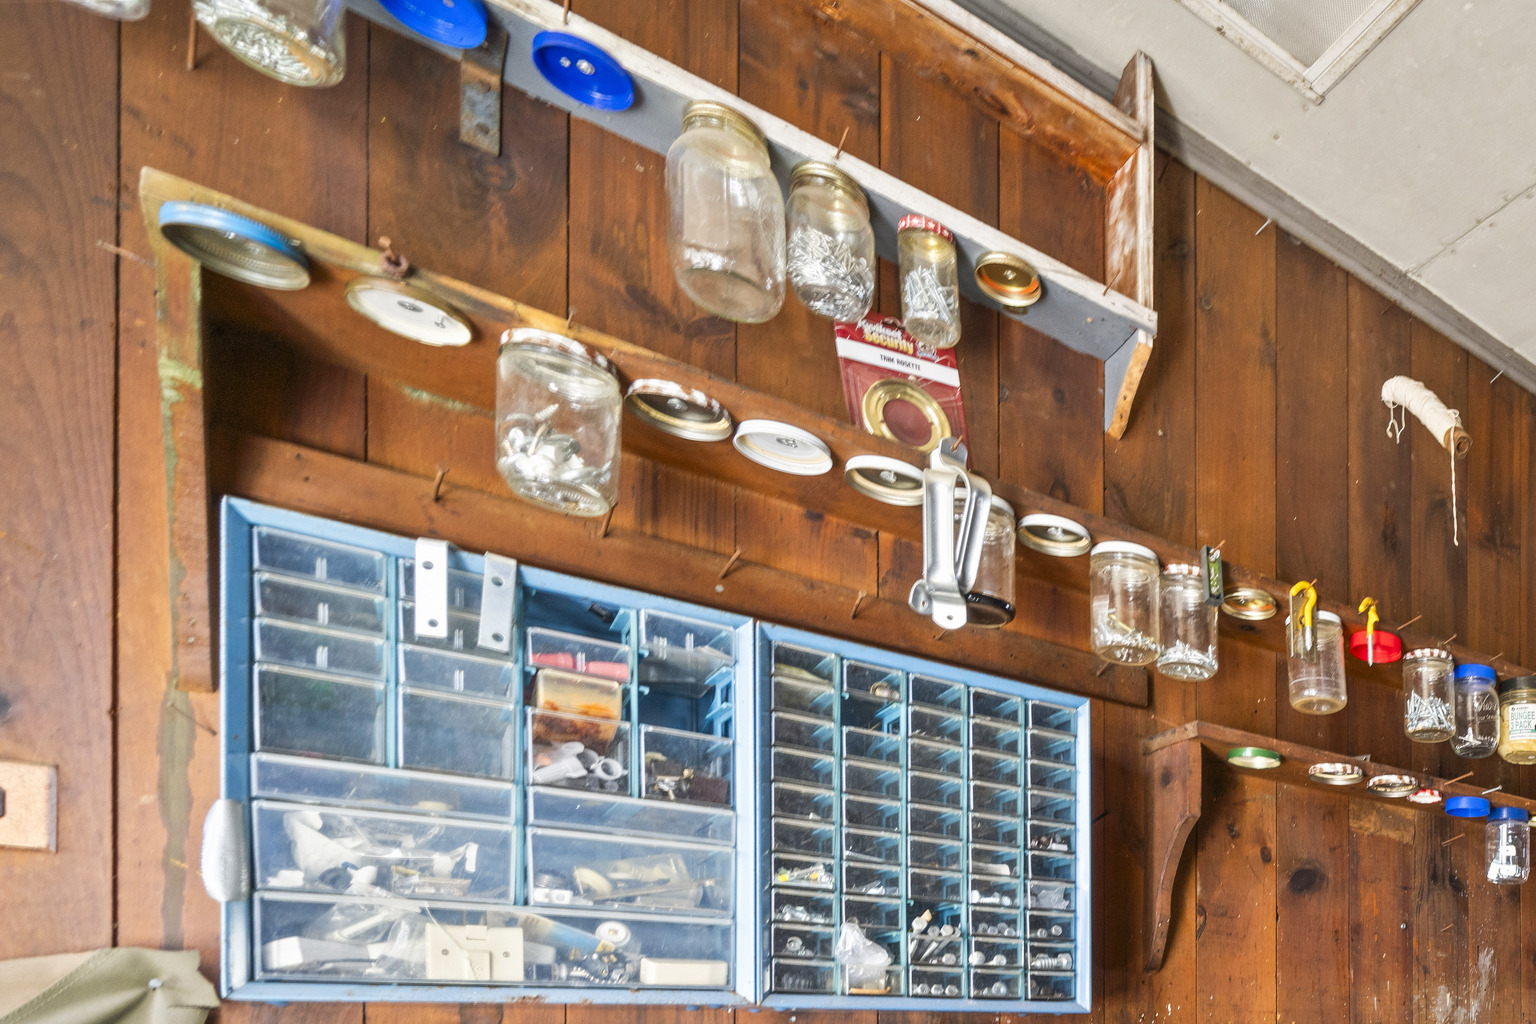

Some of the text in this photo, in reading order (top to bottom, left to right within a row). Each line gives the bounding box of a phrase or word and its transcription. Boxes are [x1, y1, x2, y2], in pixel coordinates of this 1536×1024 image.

[855, 319, 903, 341] Kwikset
[863, 329, 914, 356] Security
[880, 354, 921, 371] TRIM ROSETTE
[1510, 711, 1536, 721] BUNGEE
[1510, 720, 1532, 730] 3 PACK
